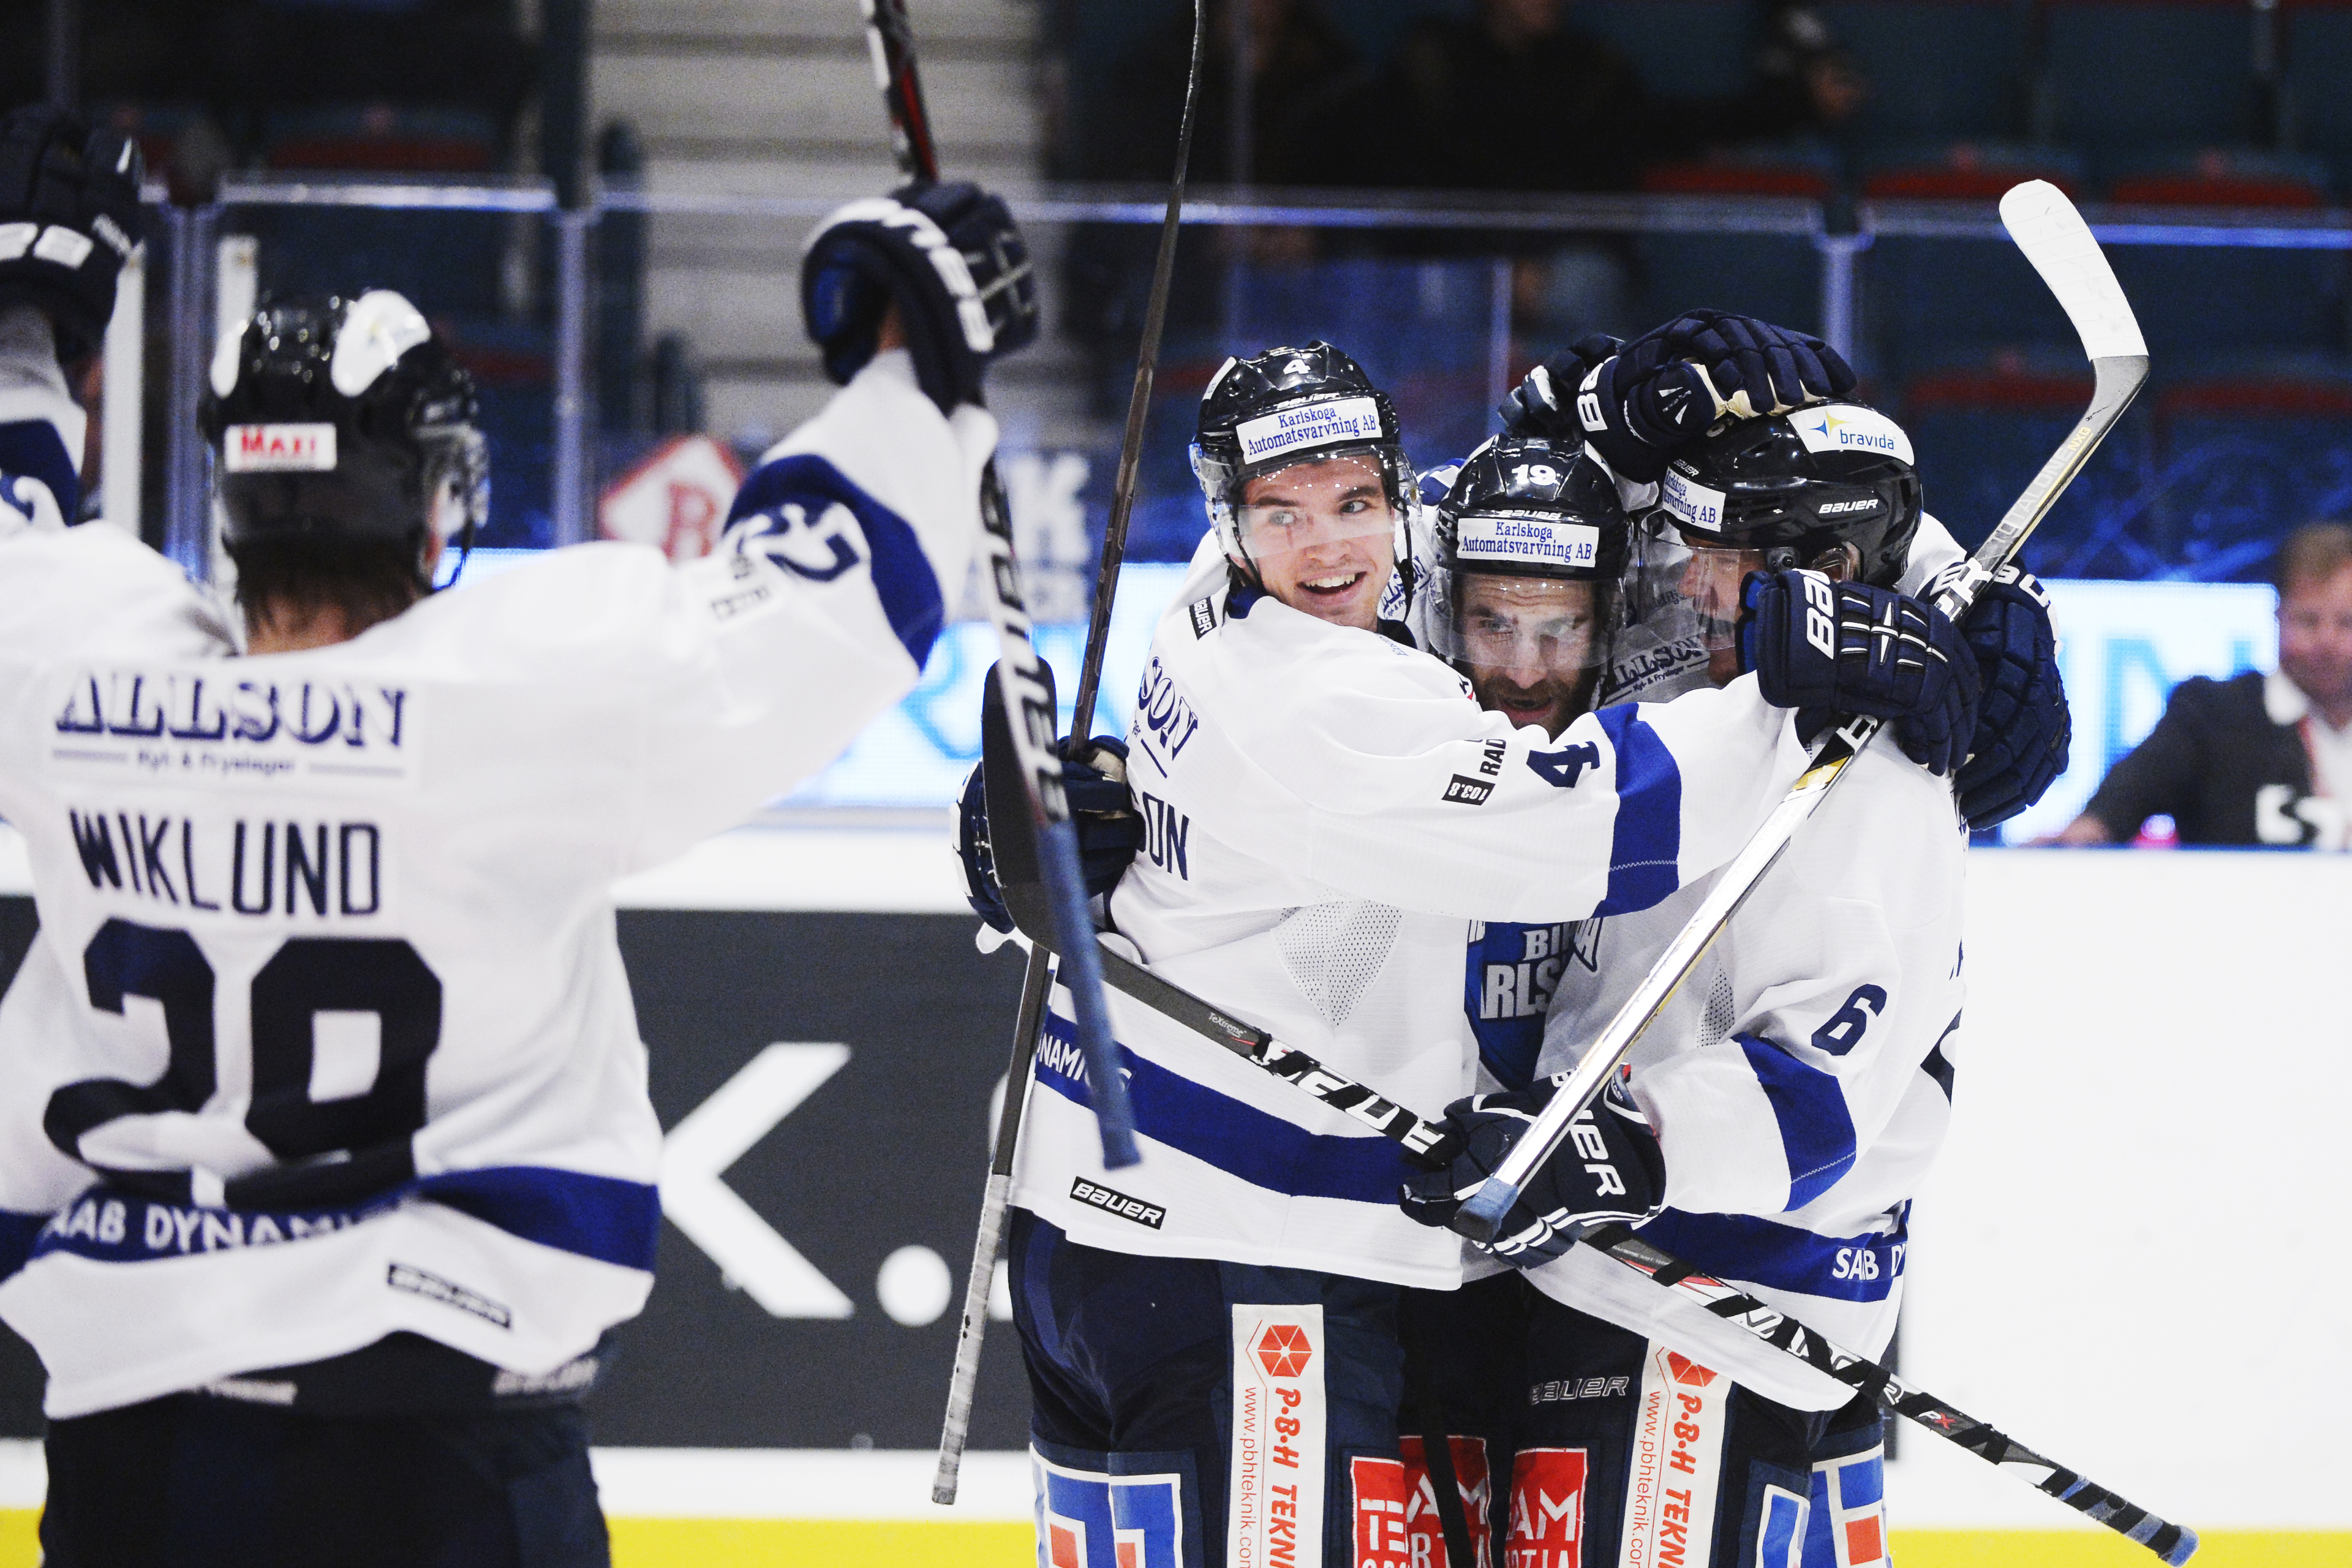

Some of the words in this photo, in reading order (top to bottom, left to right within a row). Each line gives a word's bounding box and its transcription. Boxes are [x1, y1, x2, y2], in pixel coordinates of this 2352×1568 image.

[1283, 359, 1311, 375] 4
[1278, 407, 1337, 428] Karlskoga
[1248, 417, 1360, 456] Automatsvarvning
[1363, 414, 1377, 431] AB
[1839, 429, 1894, 450] bravida
[1511, 464, 1558, 486] 19
[1499, 509, 1562, 519] BAUER
[1698, 505, 1716, 524] AB
[1818, 499, 1879, 514] BAUER
[1495, 522, 1553, 543] Karlskoga
[1461, 535, 1572, 563] Automatsvarvning
[1575, 543, 1593, 560] AB
[54, 672, 407, 748] ALLSON
[1526, 741, 1601, 788] 4
[1448, 782, 1489, 801] 103.8
[69, 807, 382, 918] WIKLUND
[1811, 983, 1887, 1057] 6
[1072, 1182, 1163, 1225] BAUER
[1531, 1376, 1629, 1406] BAUER
